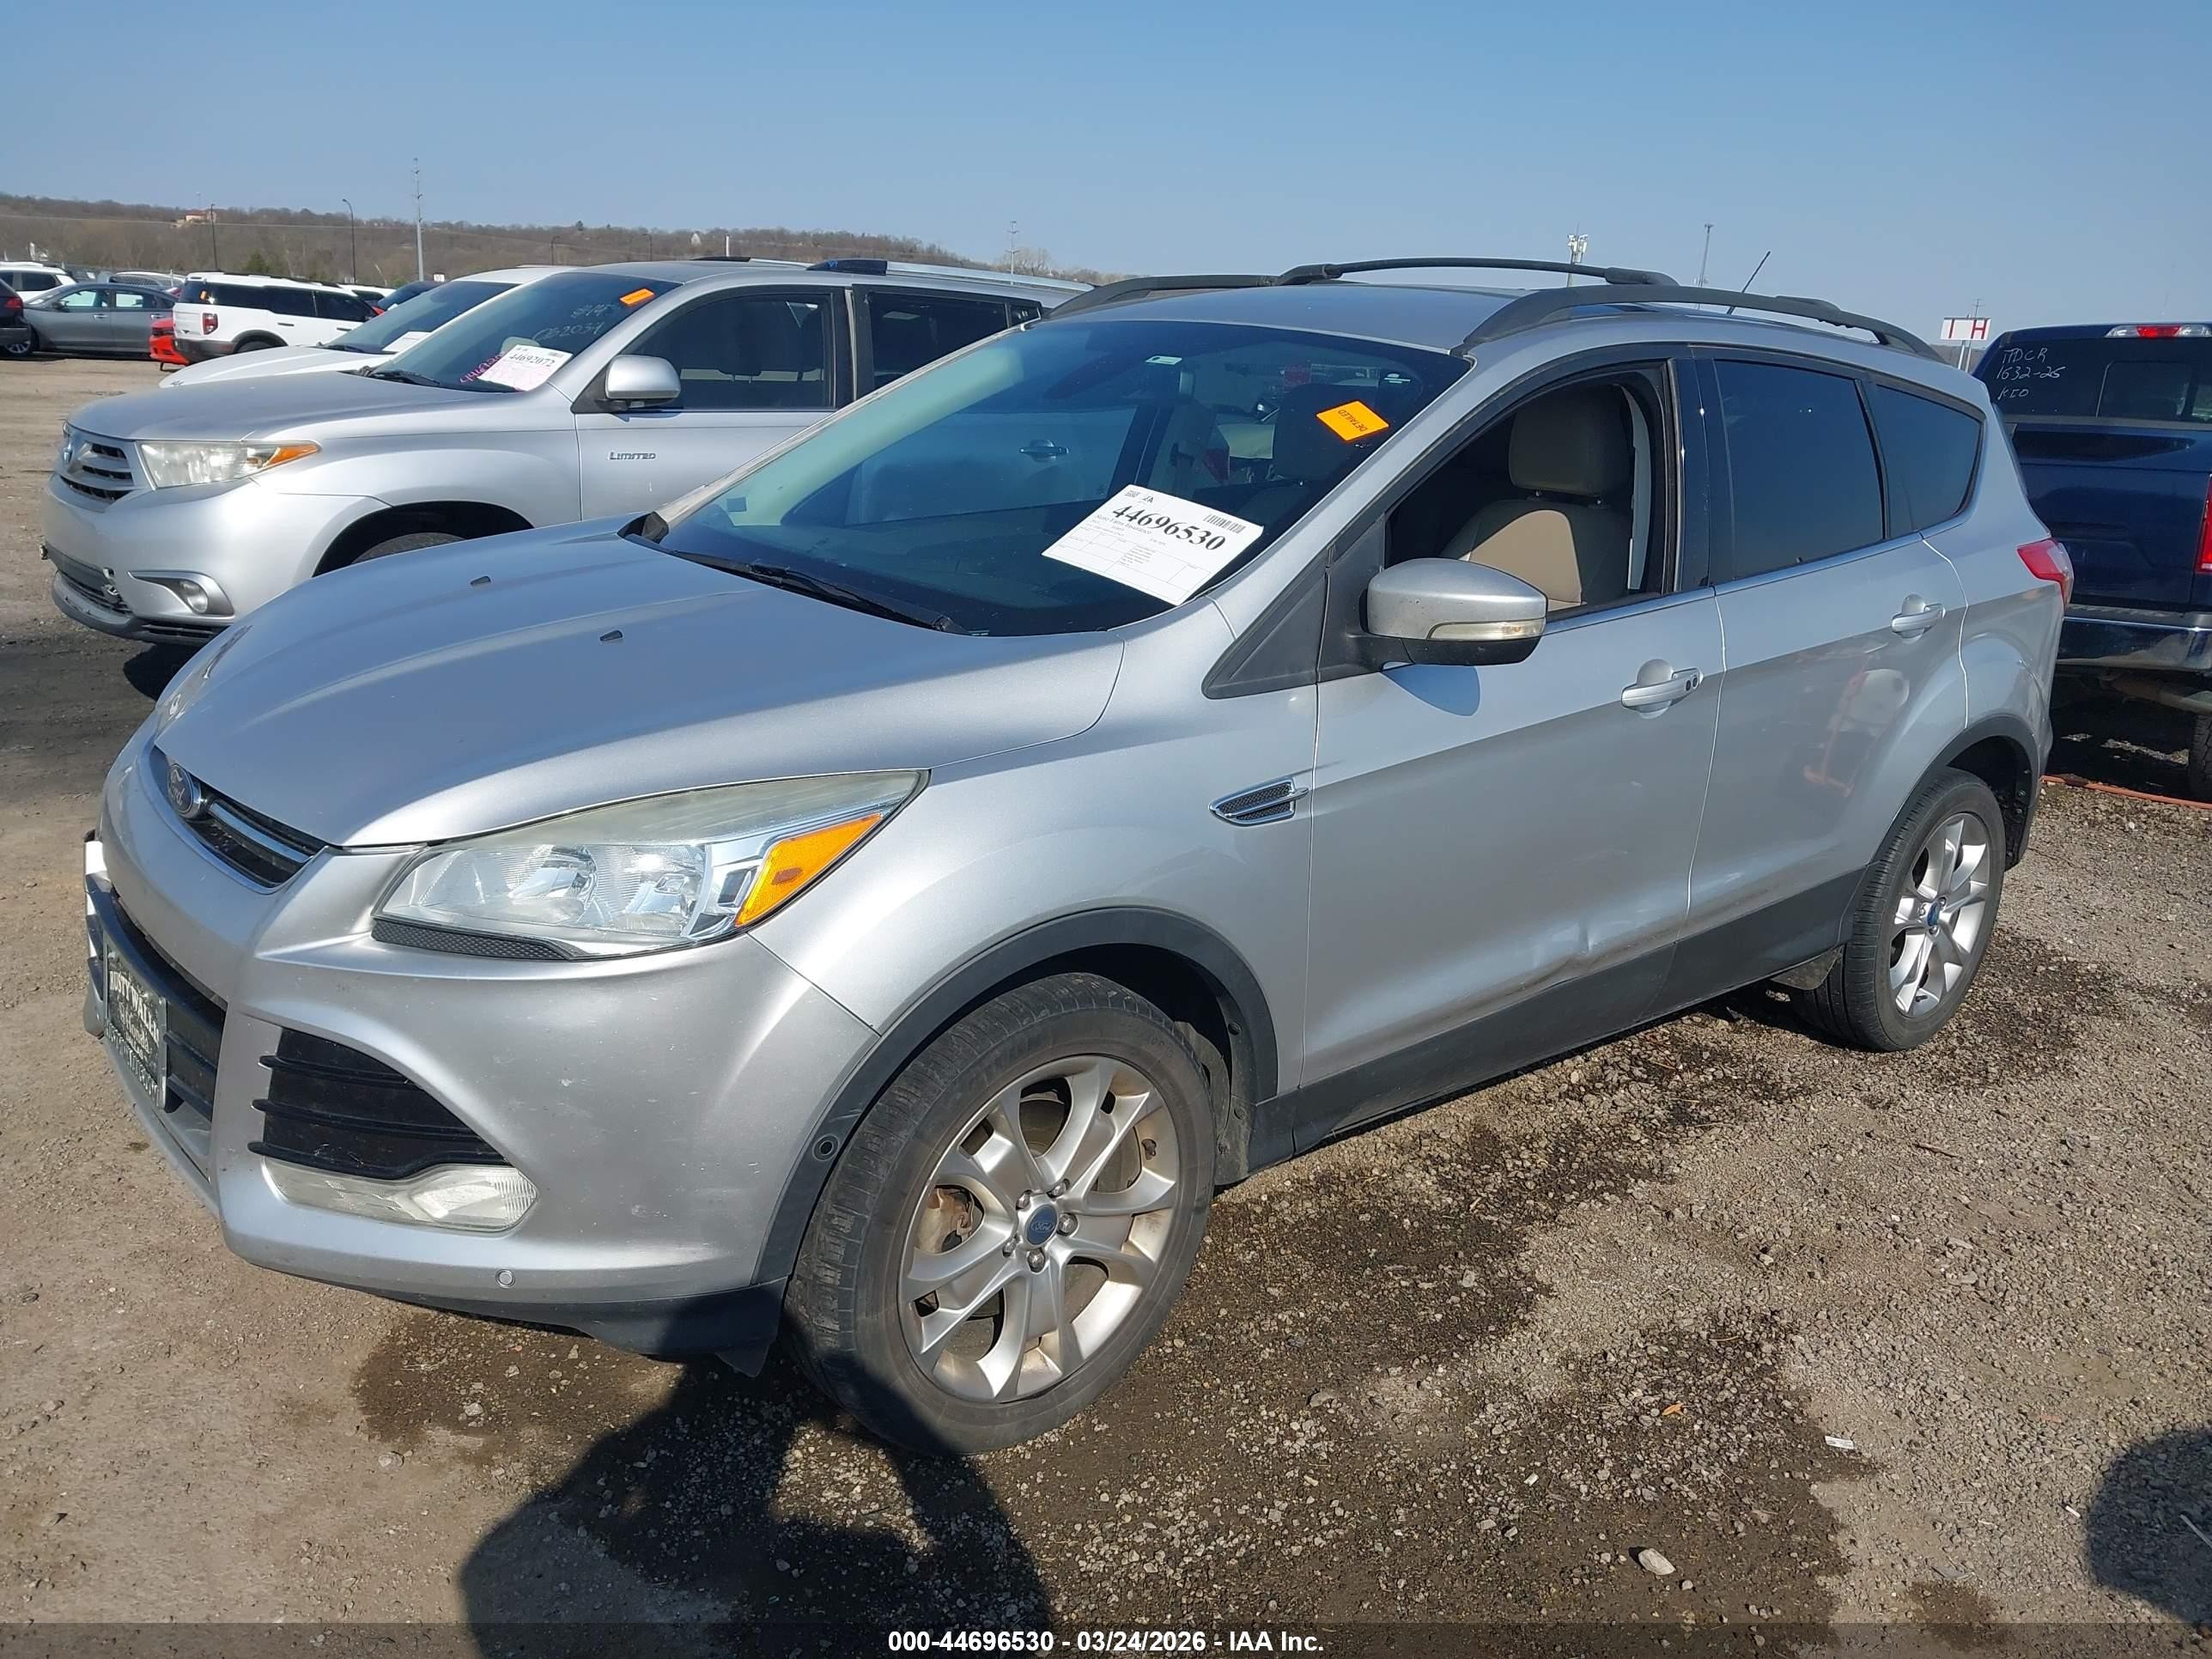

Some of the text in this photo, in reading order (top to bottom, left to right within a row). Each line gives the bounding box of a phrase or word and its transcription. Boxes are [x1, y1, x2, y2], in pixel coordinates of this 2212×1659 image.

[1971, 319, 1988, 339] H
[1338, 409, 1368, 432] DETAILED
[1112, 505, 1226, 550] 44696530
